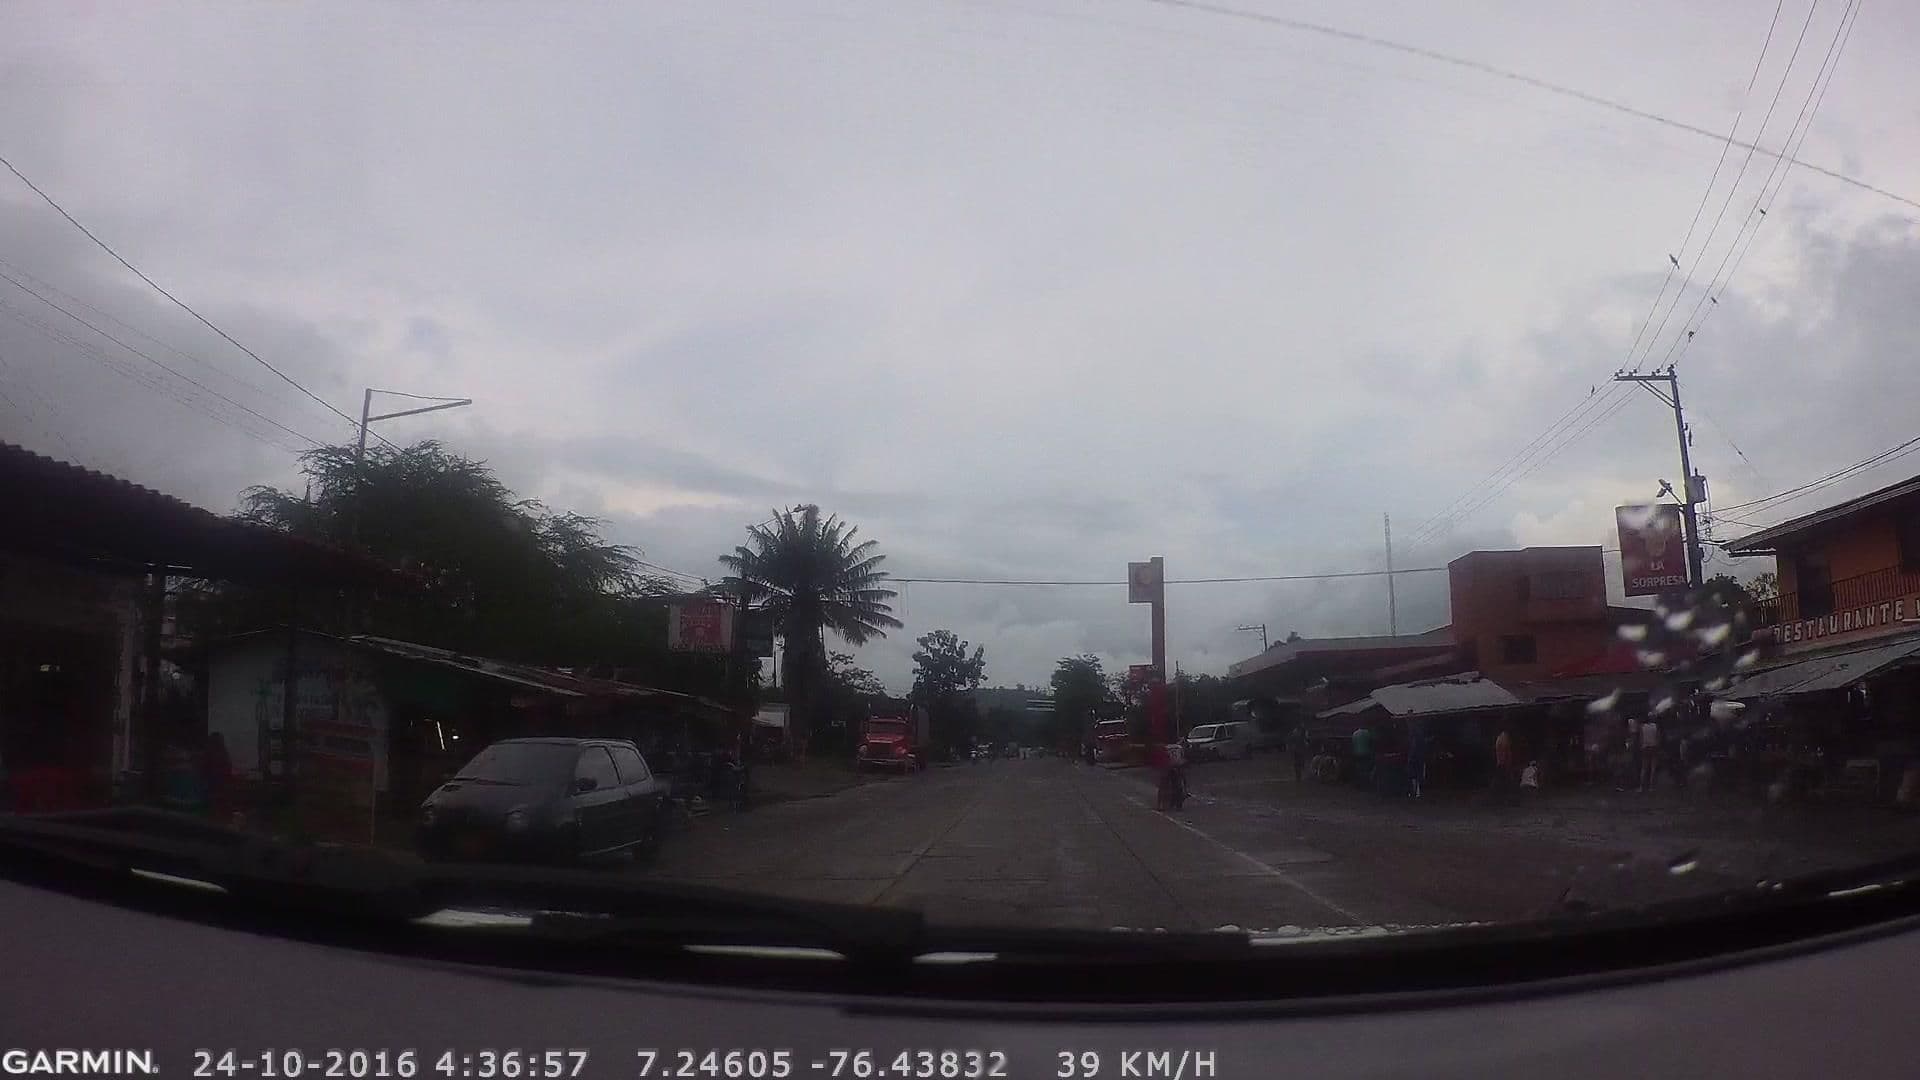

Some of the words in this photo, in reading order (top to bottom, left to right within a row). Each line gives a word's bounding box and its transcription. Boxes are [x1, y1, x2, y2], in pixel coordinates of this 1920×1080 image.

[1650, 559, 1665, 571] LA
[1632, 575, 1686, 588] SORPRESA
[1773, 598, 1905, 643] RESTAURANTE
